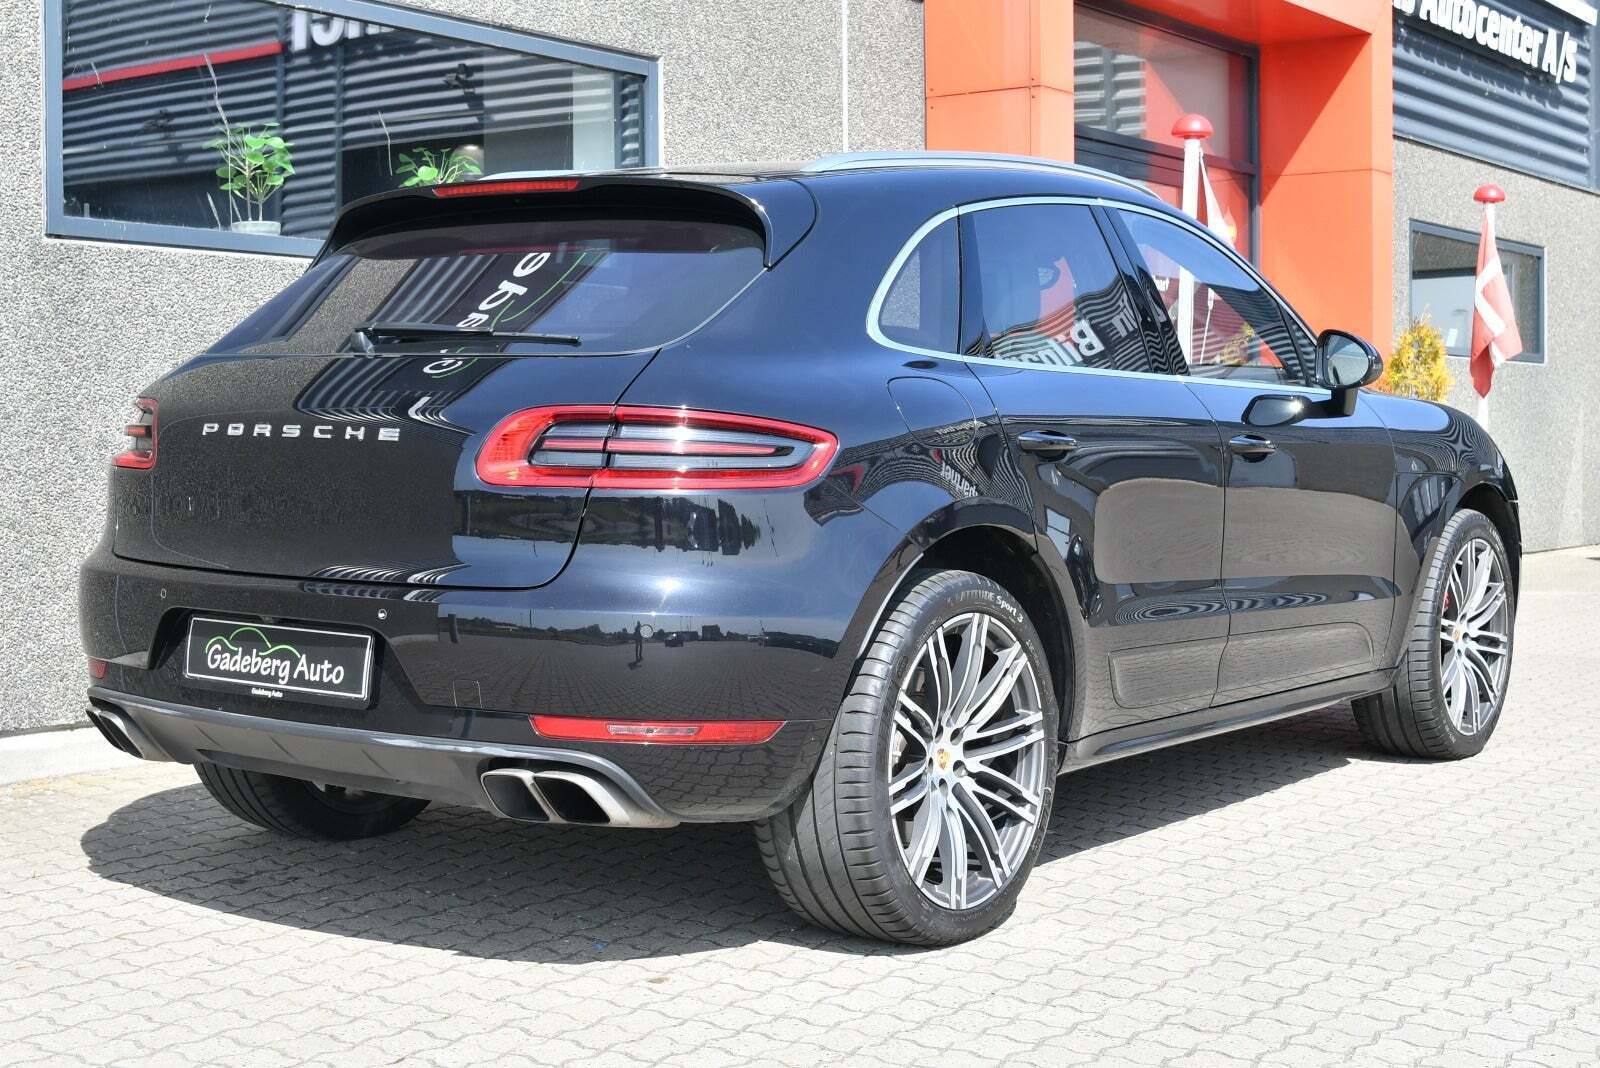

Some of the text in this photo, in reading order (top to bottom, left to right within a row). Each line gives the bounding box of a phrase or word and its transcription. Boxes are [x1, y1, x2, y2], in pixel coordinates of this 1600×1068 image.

[202, 423, 400, 441] PORSCHE
[996, 595, 1017, 617] Sport
[1016, 612, 1024, 623] 3
[207, 644, 345, 685] Gadeberg Auto
[272, 689, 283, 698] Auto
